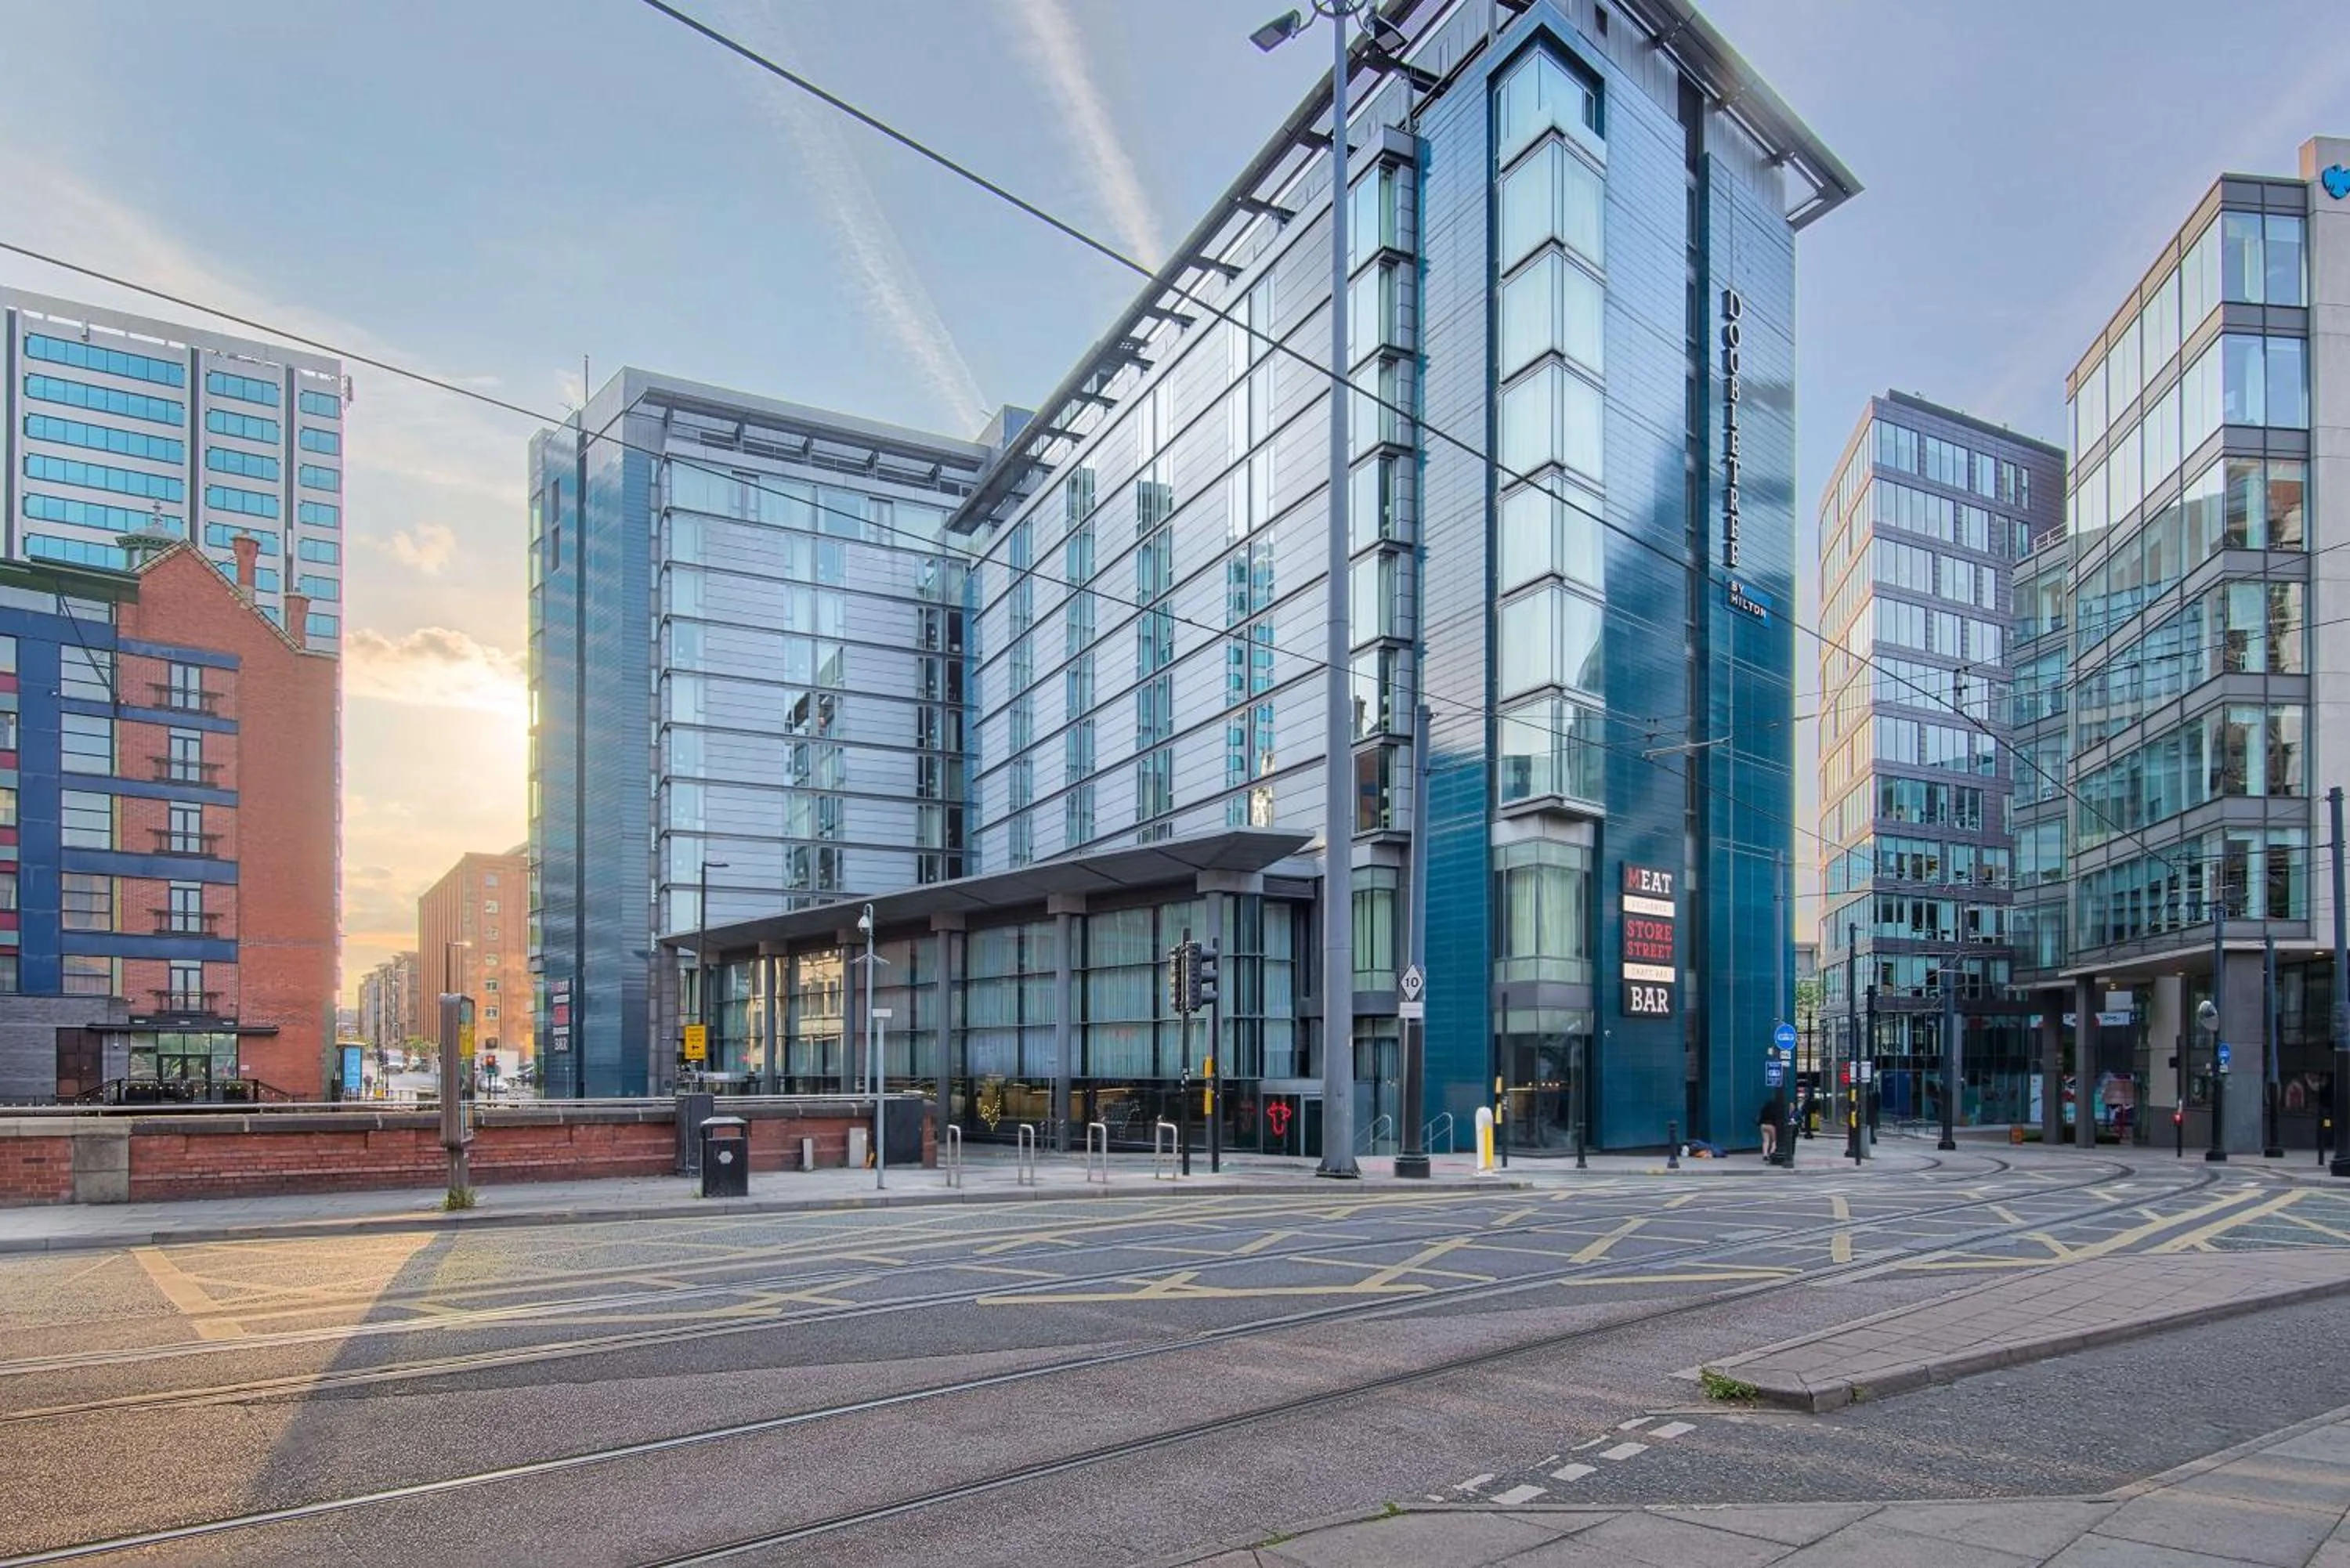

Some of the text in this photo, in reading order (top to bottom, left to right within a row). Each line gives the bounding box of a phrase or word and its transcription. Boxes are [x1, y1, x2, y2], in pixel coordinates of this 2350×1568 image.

[1723, 288, 1743, 567] DOUBLETREE
[1731, 580, 1744, 594] BY
[1730, 594, 1767, 619] HILTON
[1627, 867, 1672, 894] MEAT
[1627, 919, 1672, 941] STORE
[1627, 941, 1672, 959] STREET
[1405, 977, 1419, 988] 10
[1630, 985, 1669, 1013] BAR
